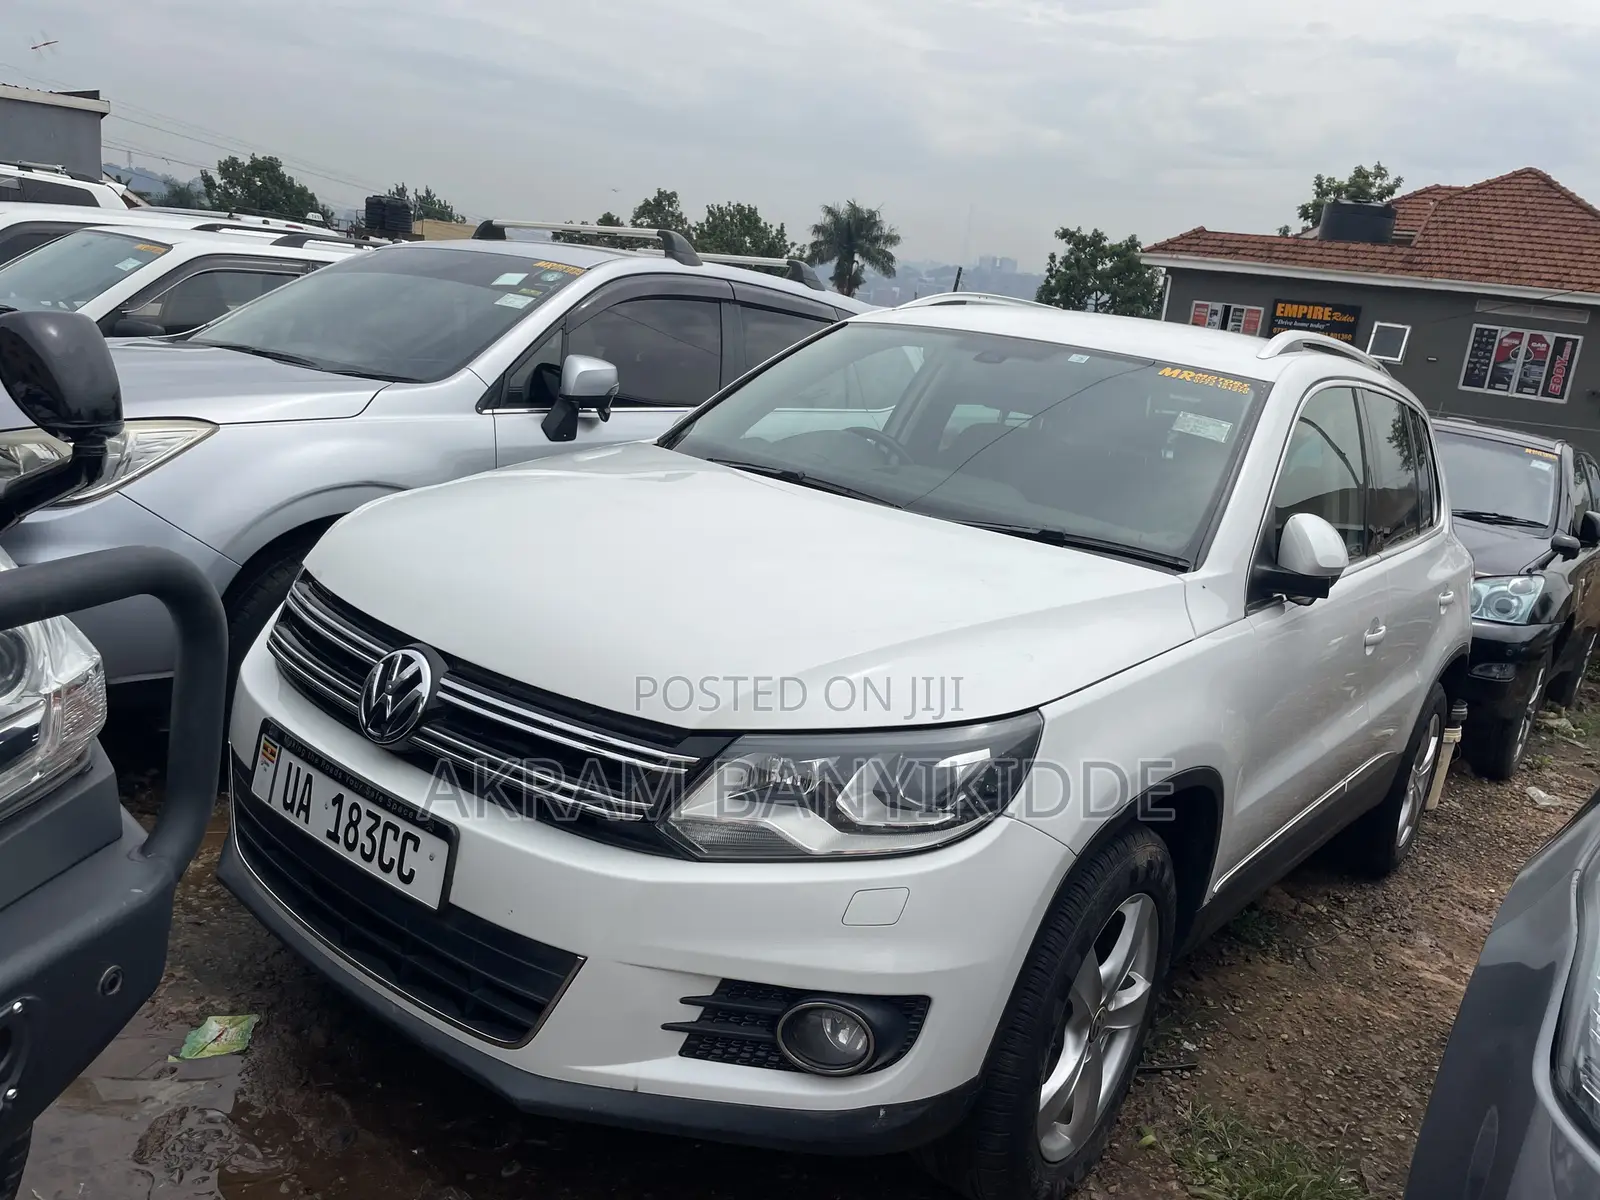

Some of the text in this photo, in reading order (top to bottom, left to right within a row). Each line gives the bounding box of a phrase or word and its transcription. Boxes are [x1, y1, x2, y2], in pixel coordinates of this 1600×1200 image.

[1276, 303, 1333, 320] EMPIRE
[1332, 311, 1355, 322] Rides
[1548, 355, 1569, 396] EDDY
[307, 751, 320, 764] the
[321, 761, 343, 780] Roads
[345, 775, 363, 790] Your
[365, 786, 383, 803] Safe
[386, 799, 414, 819] Space
[282, 761, 421, 885] UA 183CC
